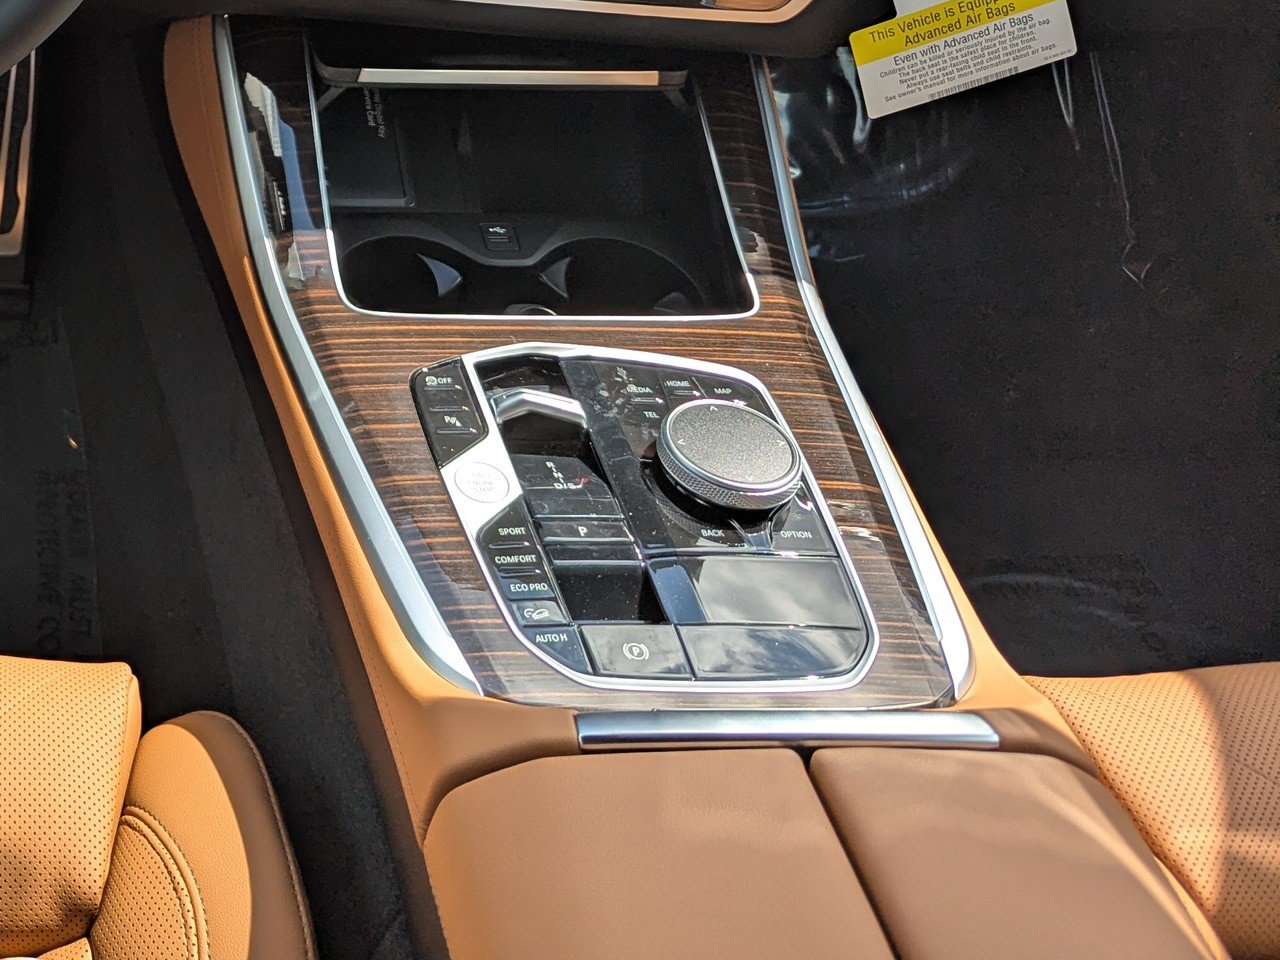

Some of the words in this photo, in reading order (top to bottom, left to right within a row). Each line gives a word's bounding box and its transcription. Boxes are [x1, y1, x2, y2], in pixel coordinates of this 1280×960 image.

[868, 26, 896, 43] This
[897, 12, 941, 33] Vehicle
[943, 6, 956, 19] is
[904, 18, 962, 47] Advanced
[965, 12, 982, 27] Air
[985, 2, 1016, 19] Bags
[893, 51, 918, 67] Even
[919, 43, 941, 58] with
[943, 26, 990, 50] Advanced
[993, 21, 1007, 34] Air
[1008, 13, 1034, 28] Bags
[880, 65, 906, 79] Children
[907, 62, 919, 70] can
[928, 52, 946, 62] killed
[955, 41, 983, 54] seriously
[984, 32, 1006, 44] injured
[1017, 25, 1027, 33] the
[1038, 17, 1052, 27] bag.
[899, 70, 910, 79] The
[911, 65, 926, 75] back
[927, 61, 941, 70] seat
[948, 54, 959, 63] the
[960, 48, 979, 59] safest
[980, 43, 997, 53] place
[1009, 29, 1037, 43] children.
[899, 76, 918, 85] Never
[919, 72, 930, 81] put
[936, 57, 969, 73] rear-facing
[970, 50, 986, 62] child
[987, 46, 1000, 56] seat
[1009, 40, 1019, 49] the
[906, 78, 928, 90] Always
[929, 74, 940, 82] use
[941, 68, 955, 78] seat
[973, 59, 984, 68] and
[985, 53, 1001, 64] child
[884, 94, 897, 103] See
[923, 79, 946, 91] manual
[958, 70, 974, 80] more
[974, 58, 1011, 74] information
[1012, 51, 1030, 62] about
[626, 386, 653, 394] MEDIA
[713, 387, 732, 395] MAP
[643, 411, 660, 419] TEL
[498, 526, 526, 536] SPORT
[578, 526, 587, 537] P
[701, 529, 725, 538] BACK
[780, 530, 813, 539] OPTION
[494, 554, 537, 564] COMFORT
[509, 583, 528, 592] ECO
[529, 582, 548, 591] PRO
[535, 634, 558, 643] AUTO
[560, 633, 568, 642] H
